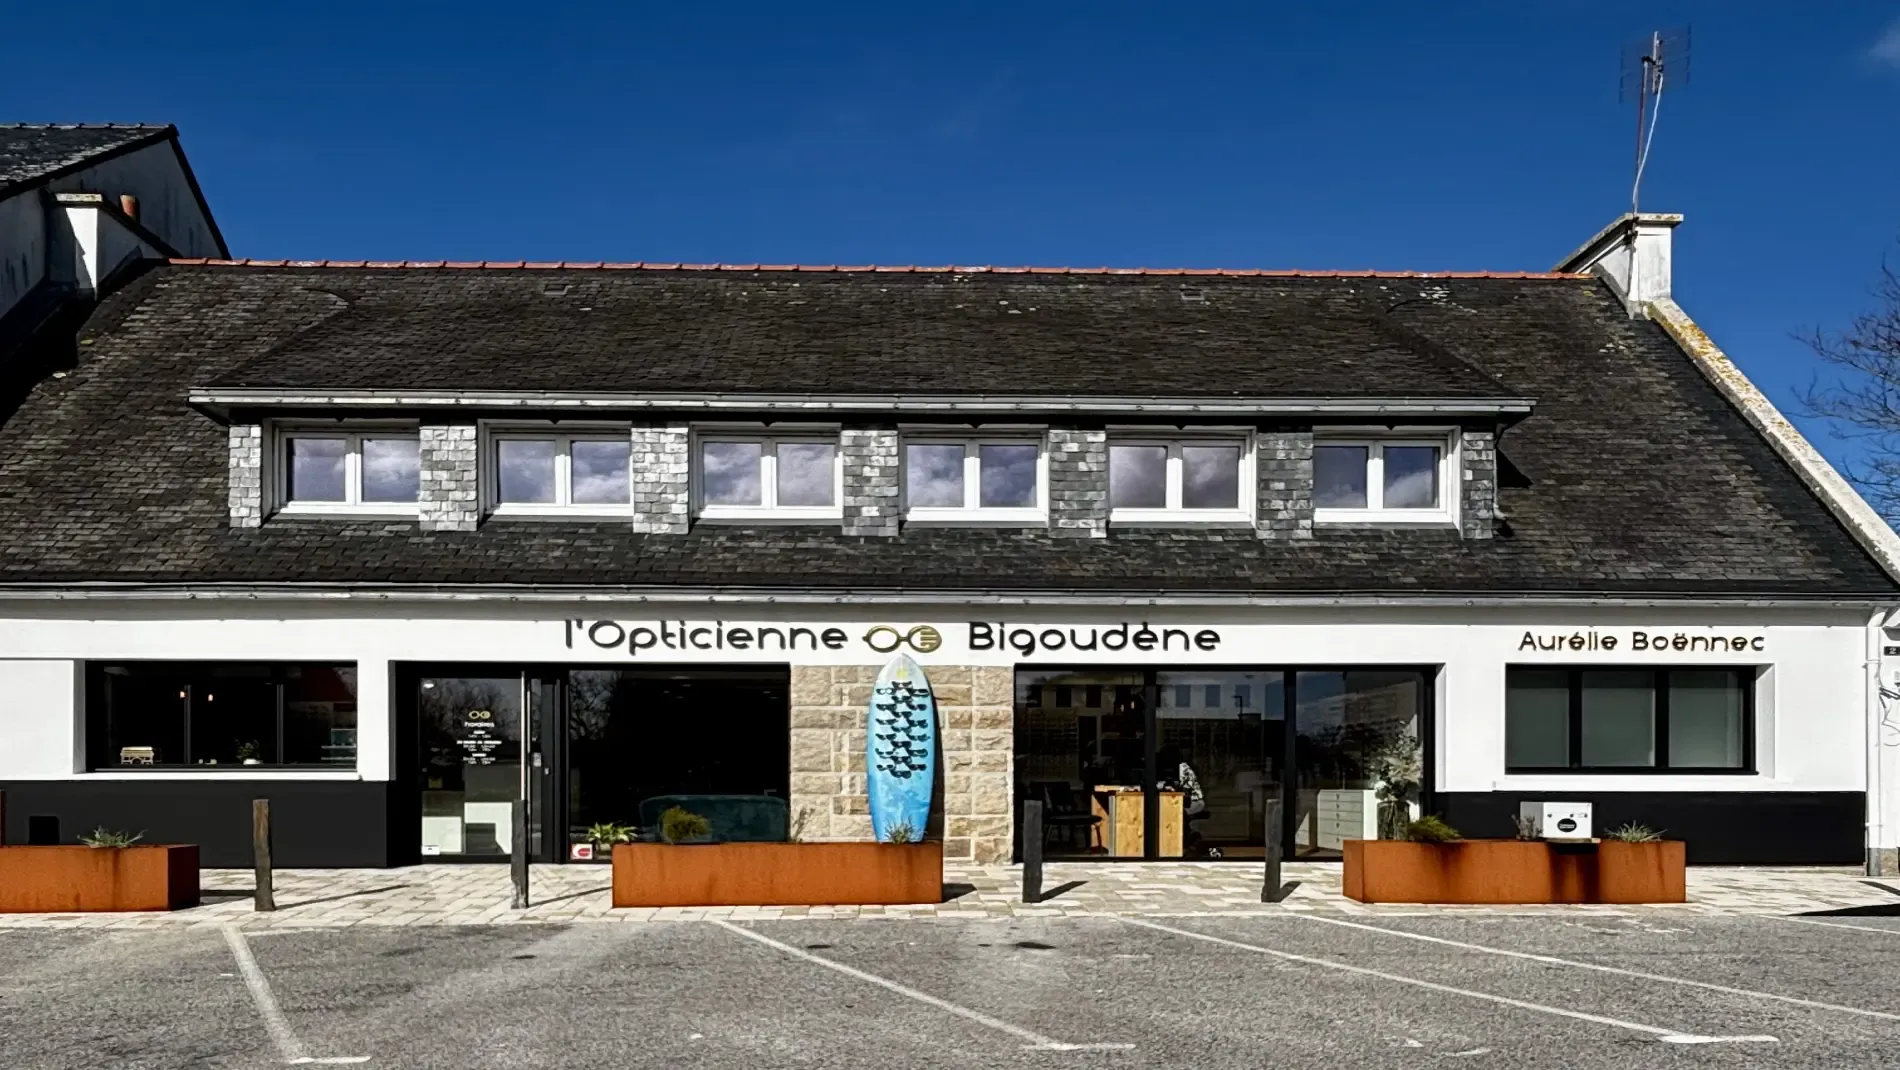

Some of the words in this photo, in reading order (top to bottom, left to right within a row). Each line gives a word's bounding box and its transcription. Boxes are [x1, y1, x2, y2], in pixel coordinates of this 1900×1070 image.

[565, 619, 848, 656] l'Opticienne
[969, 621, 1221, 657] Bigoudène
[1518, 631, 1618, 651] Aurélie
[1632, 631, 1765, 652] Boënnec
